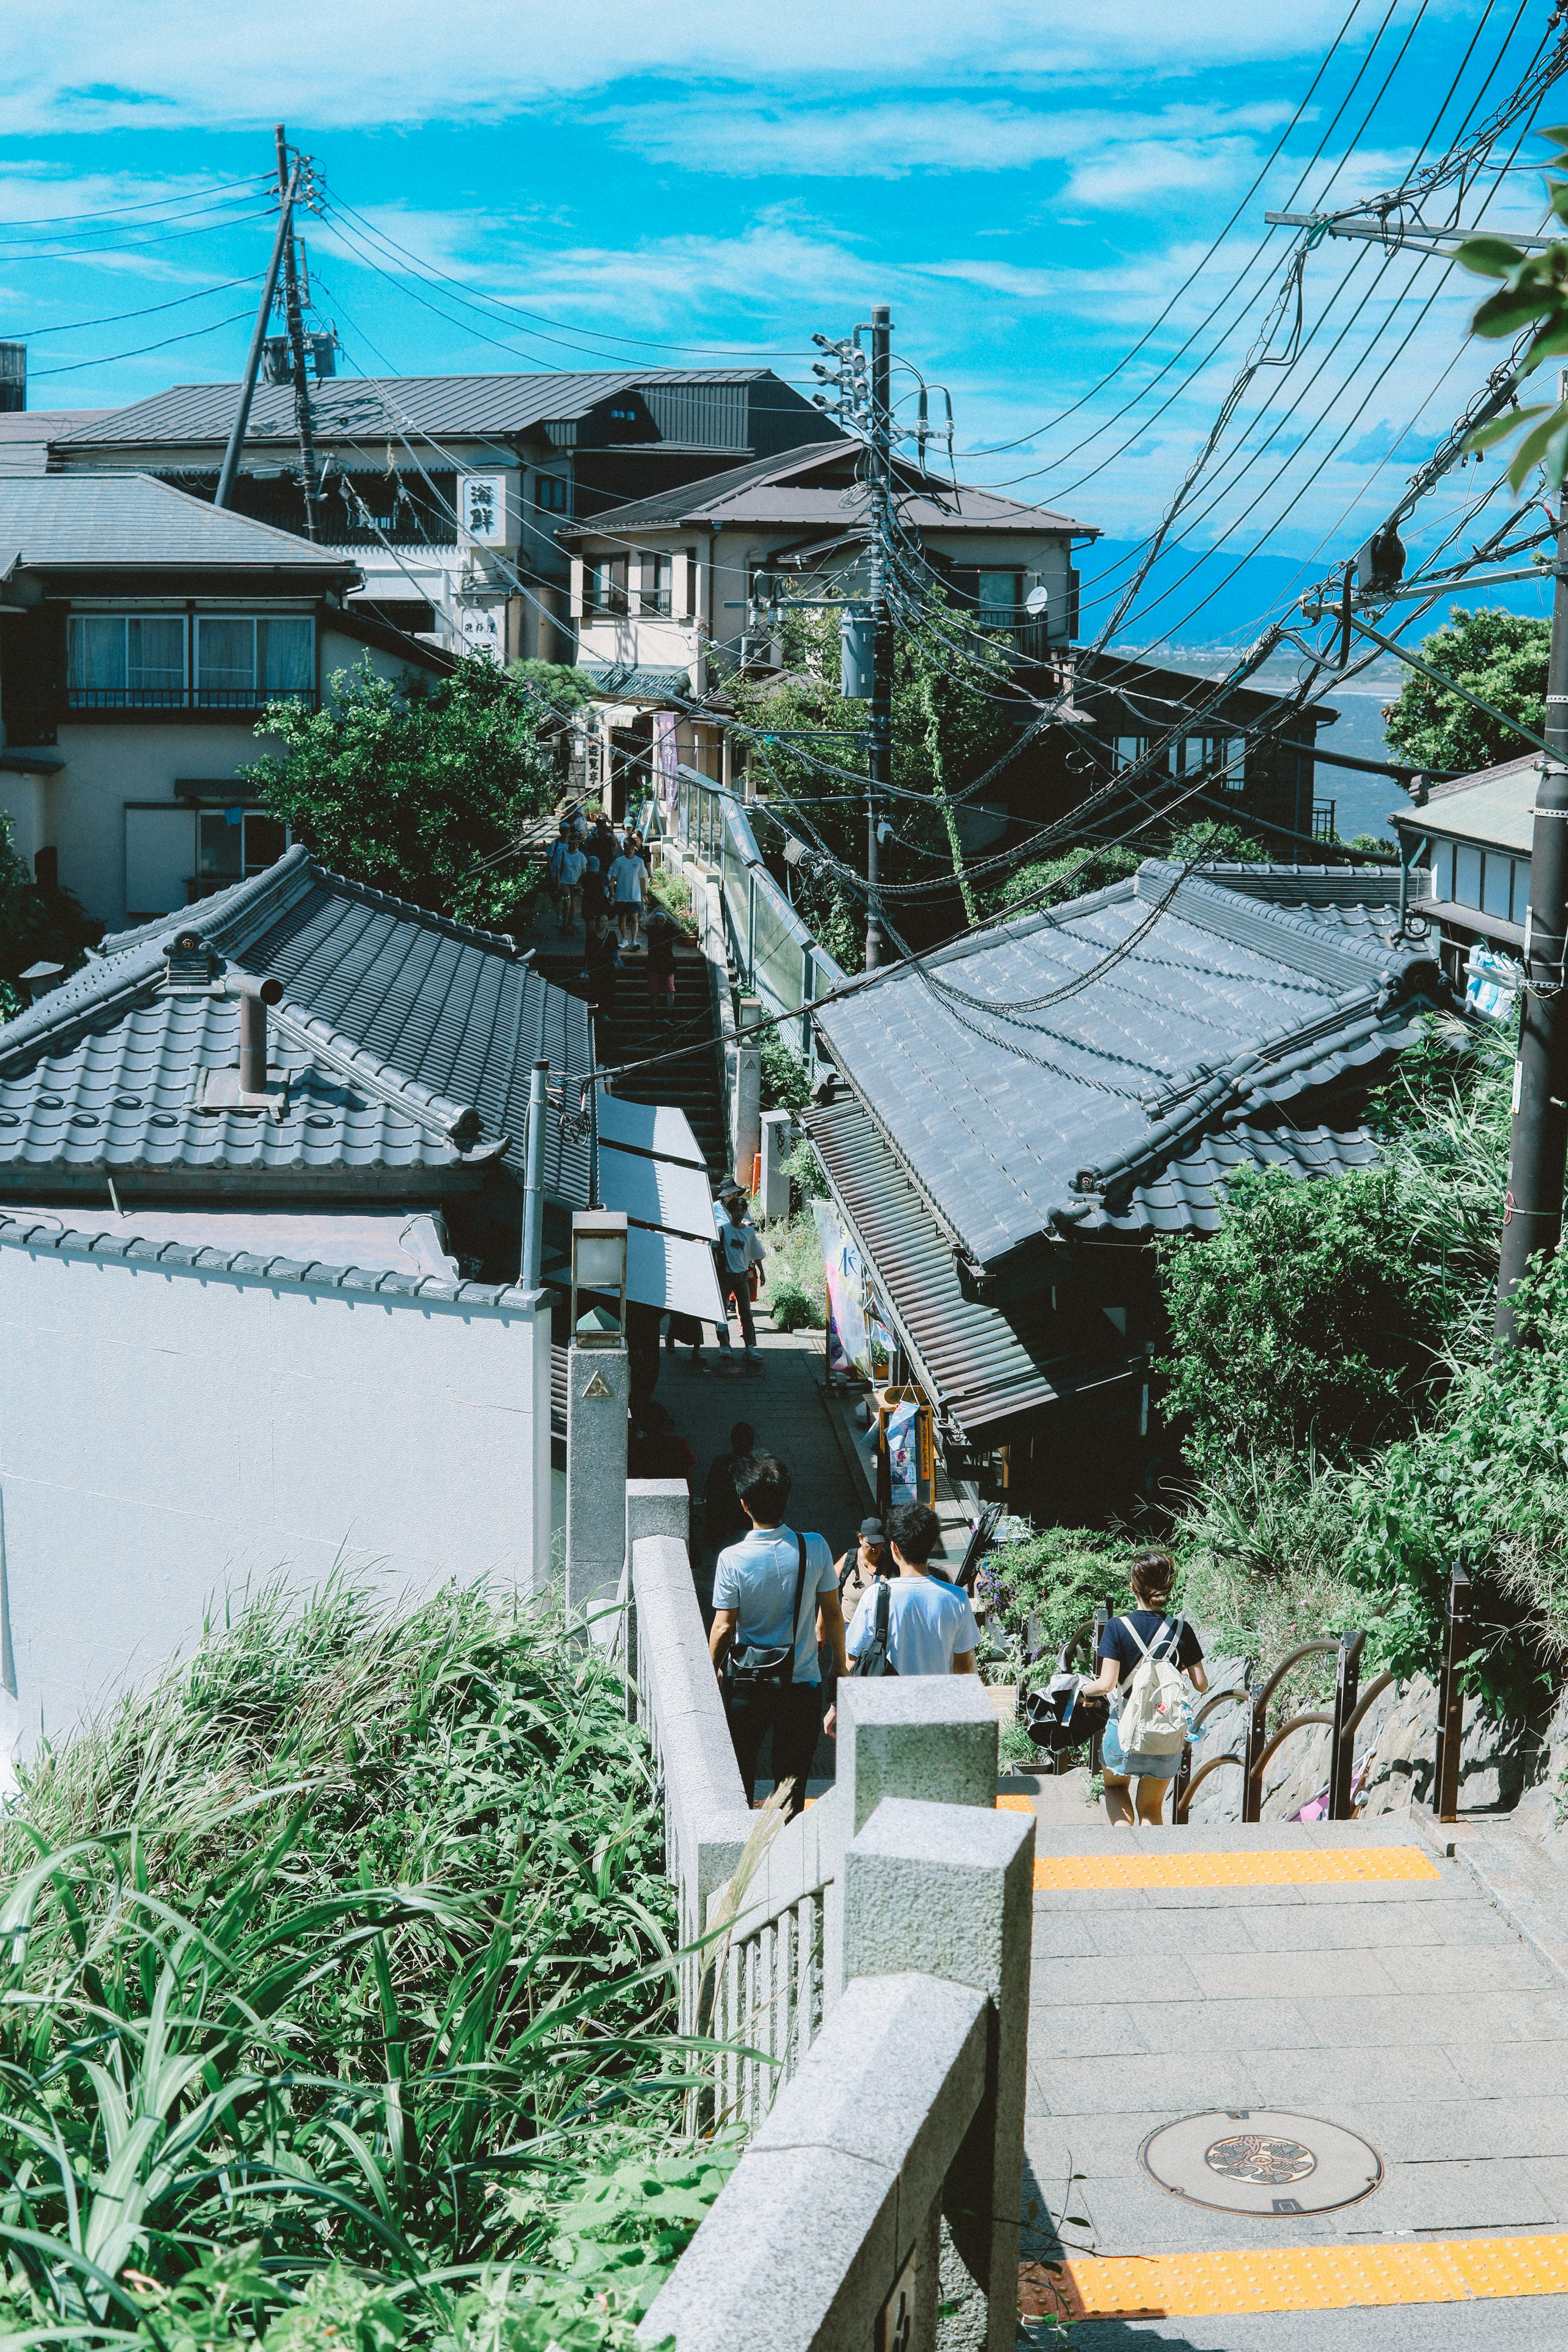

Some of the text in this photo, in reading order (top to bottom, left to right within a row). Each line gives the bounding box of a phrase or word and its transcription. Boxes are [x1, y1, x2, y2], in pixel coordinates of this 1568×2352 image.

[470, 483, 494, 535] 海鮮
[464, 622, 495, 633] 磯料理
[588, 745, 599, 785] 遊覧亭
